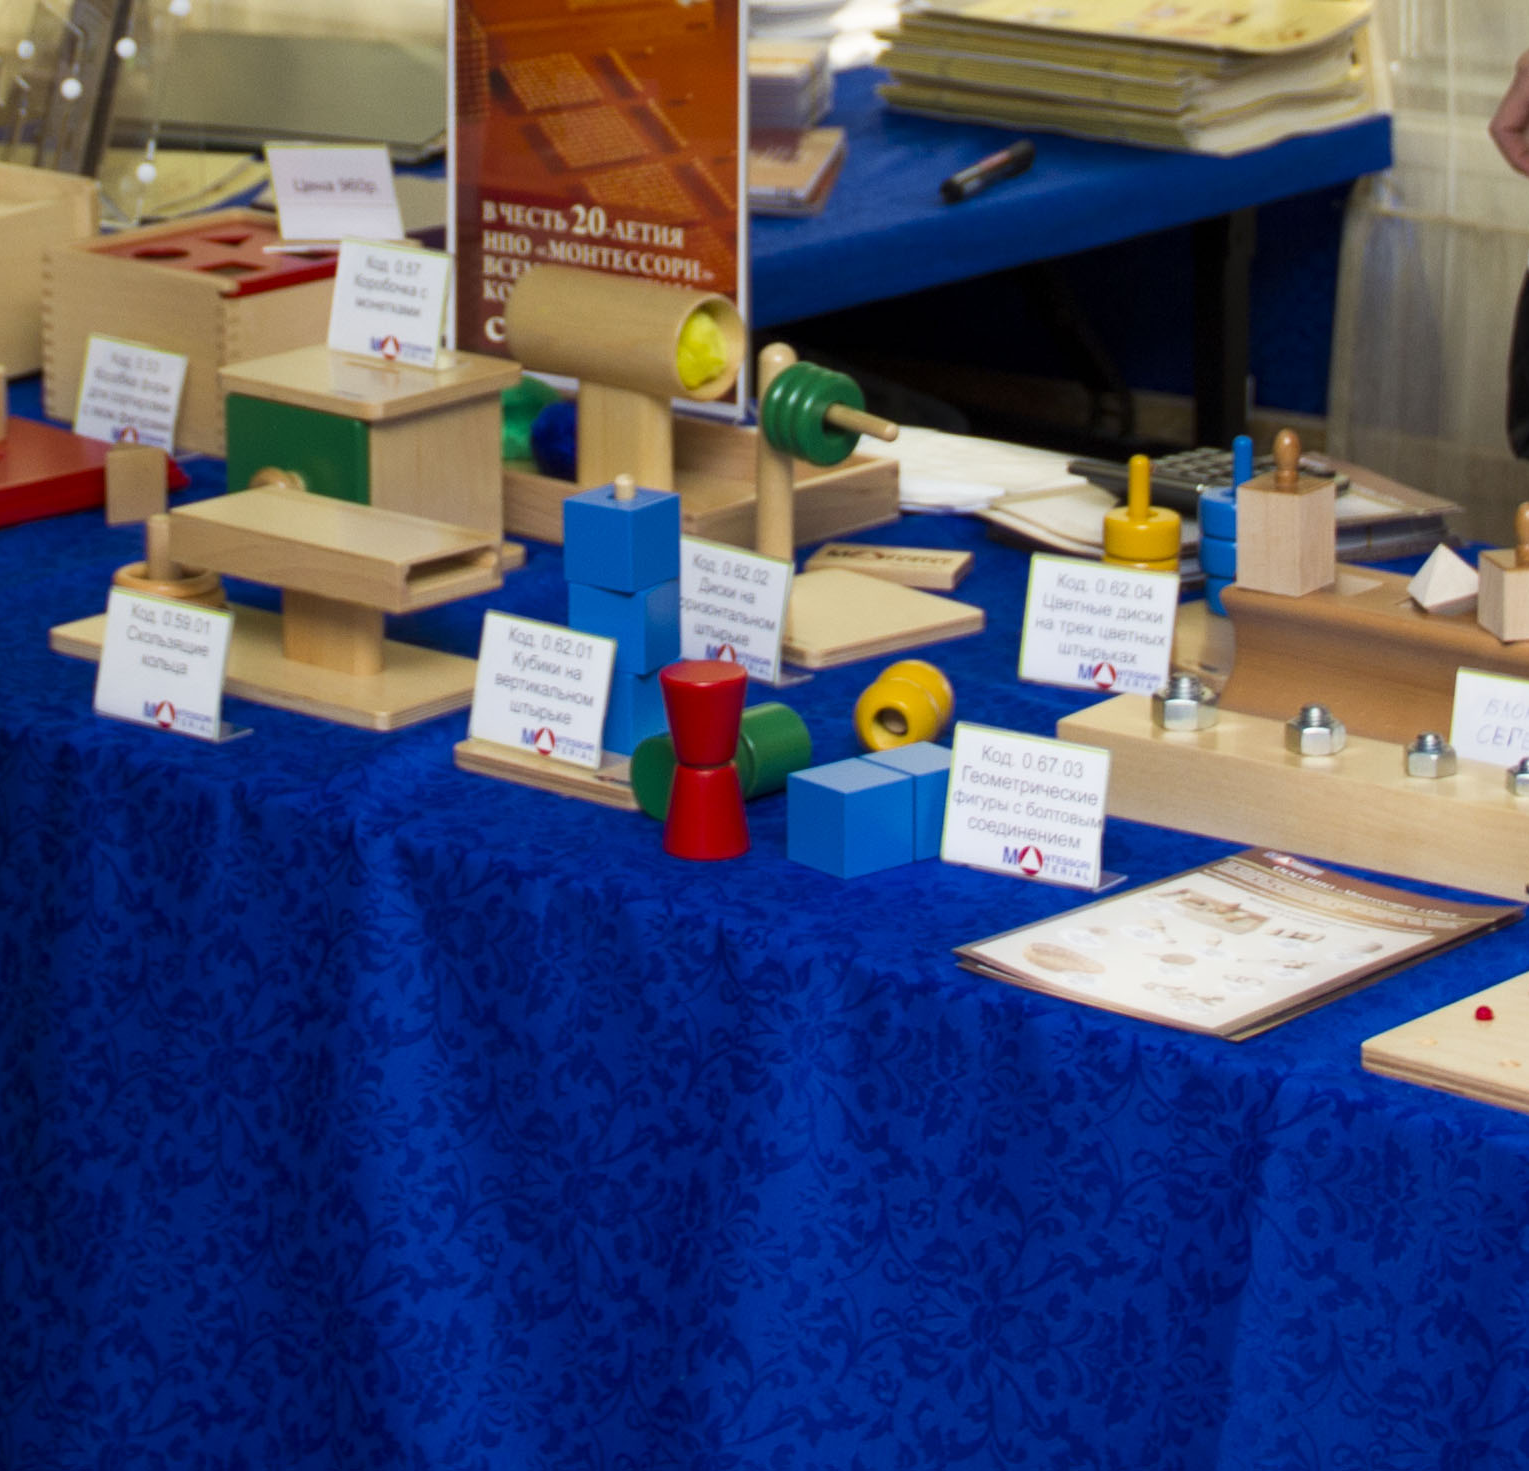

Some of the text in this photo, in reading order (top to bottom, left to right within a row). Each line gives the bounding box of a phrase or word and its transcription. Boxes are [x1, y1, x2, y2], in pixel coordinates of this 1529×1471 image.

[292, 178, 335, 195] Цена
[482, 201, 684, 249] В ЧЕСТЬ 20-ЛЕТИЯ
[483, 230, 715, 281] НПО «МОНТЕССОРИ»
[698, 577, 756, 605] Диски на
[1041, 593, 1163, 625] Цветные диски
[125, 624, 210, 657] Скользящие
[694, 623, 750, 647] штырьке
[1035, 616, 1166, 647] на трех цветных
[141, 654, 188, 675] кольца
[511, 650, 583, 680] Кубики на
[1058, 642, 1137, 665] штырьках
[494, 673, 594, 707] вертикальном
[510, 700, 572, 725] штырьке
[961, 765, 1098, 806] Геометрические
[952, 788, 1103, 830] фигуры с болтовым
[967, 816, 1082, 849] соединением
